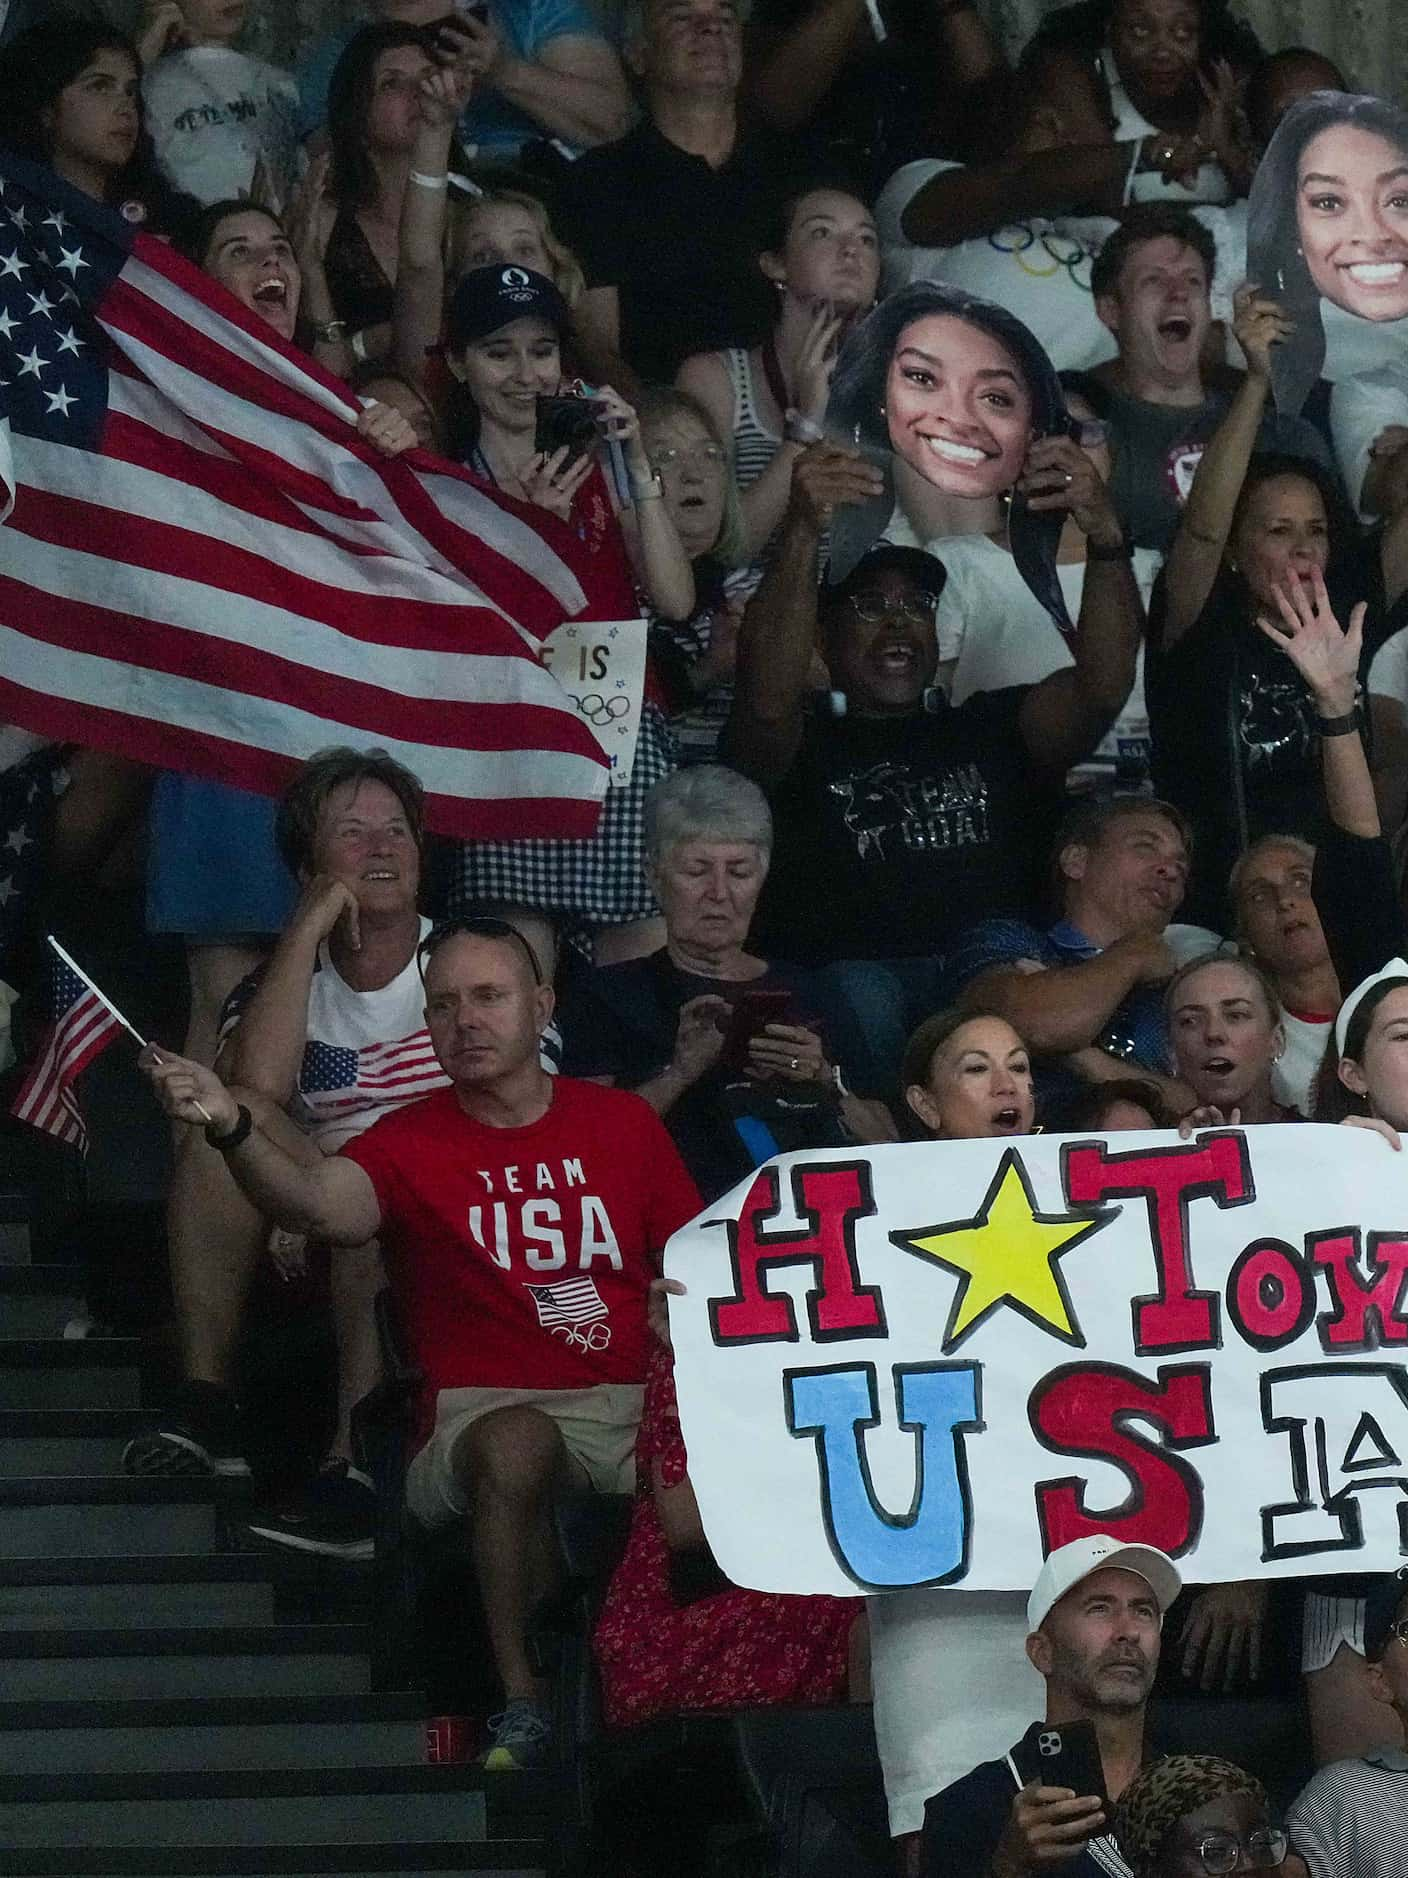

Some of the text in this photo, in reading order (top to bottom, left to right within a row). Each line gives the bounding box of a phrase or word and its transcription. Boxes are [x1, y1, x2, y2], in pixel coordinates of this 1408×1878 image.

[579, 645, 610, 681] IS
[476, 1157, 587, 1194] TEAM
[469, 1195, 624, 1271] USA
[704, 1159, 888, 1348] H
